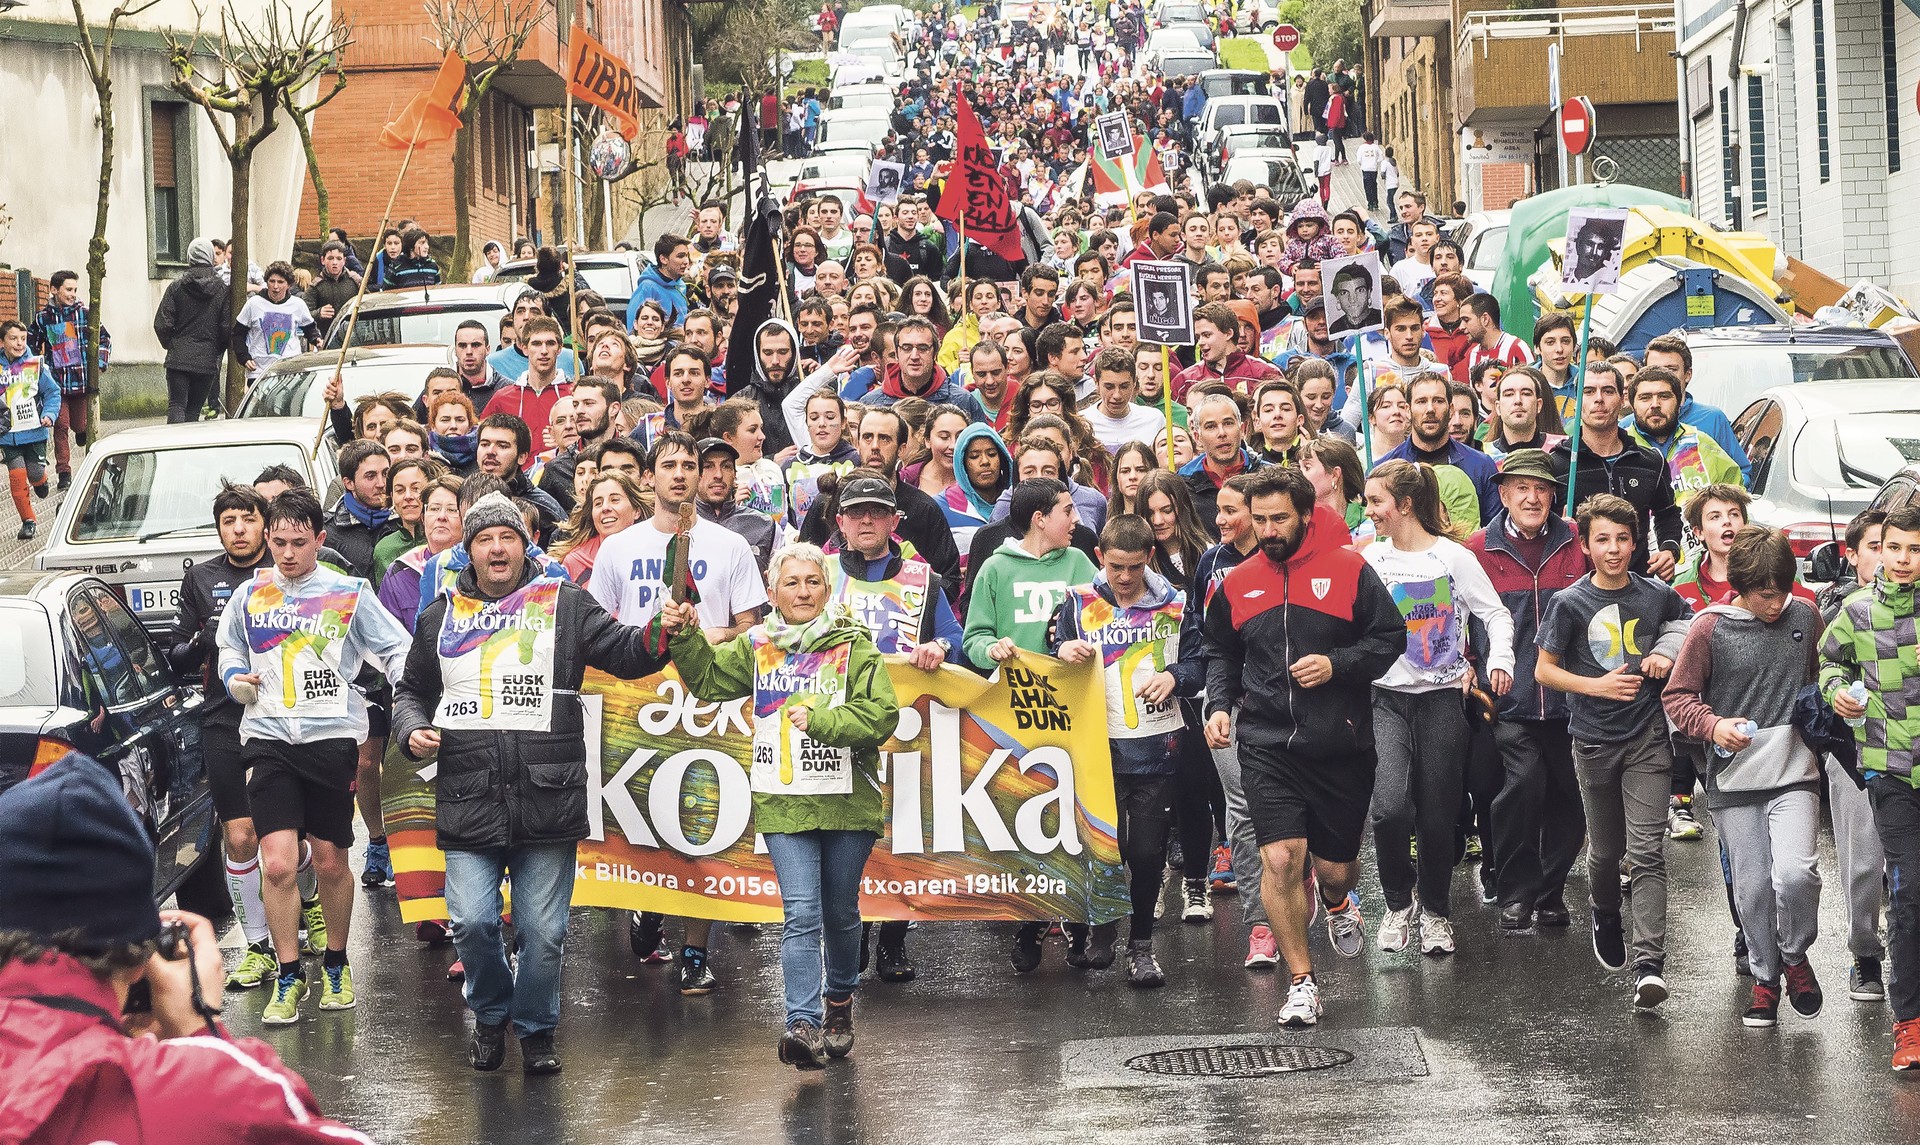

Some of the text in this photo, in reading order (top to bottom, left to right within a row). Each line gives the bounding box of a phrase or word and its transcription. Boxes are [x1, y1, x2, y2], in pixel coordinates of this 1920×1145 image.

[1274, 34, 1297, 43] STOP
[903, 563, 926, 575] aek
[278, 602, 302, 617] aek
[482, 600, 503, 615] aek
[1112, 614, 1133, 630] aek
[303, 678, 341, 691] AHAL
[502, 674, 545, 686] EUSK
[501, 685, 544, 697] AHAL
[502, 695, 542, 708] DUN!
[443, 700, 479, 718] 1263
[1015, 709, 1072, 732] DUN!
[800, 749, 843, 760] AHAL
[802, 760, 841, 772] DUN!
[595, 862, 679, 891] Bilbora
[704, 875, 782, 896] 2015e
[860, 875, 957, 896] txoaren
[964, 873, 1020, 895] 19tik
[1024, 873, 1068, 895] 29ra
